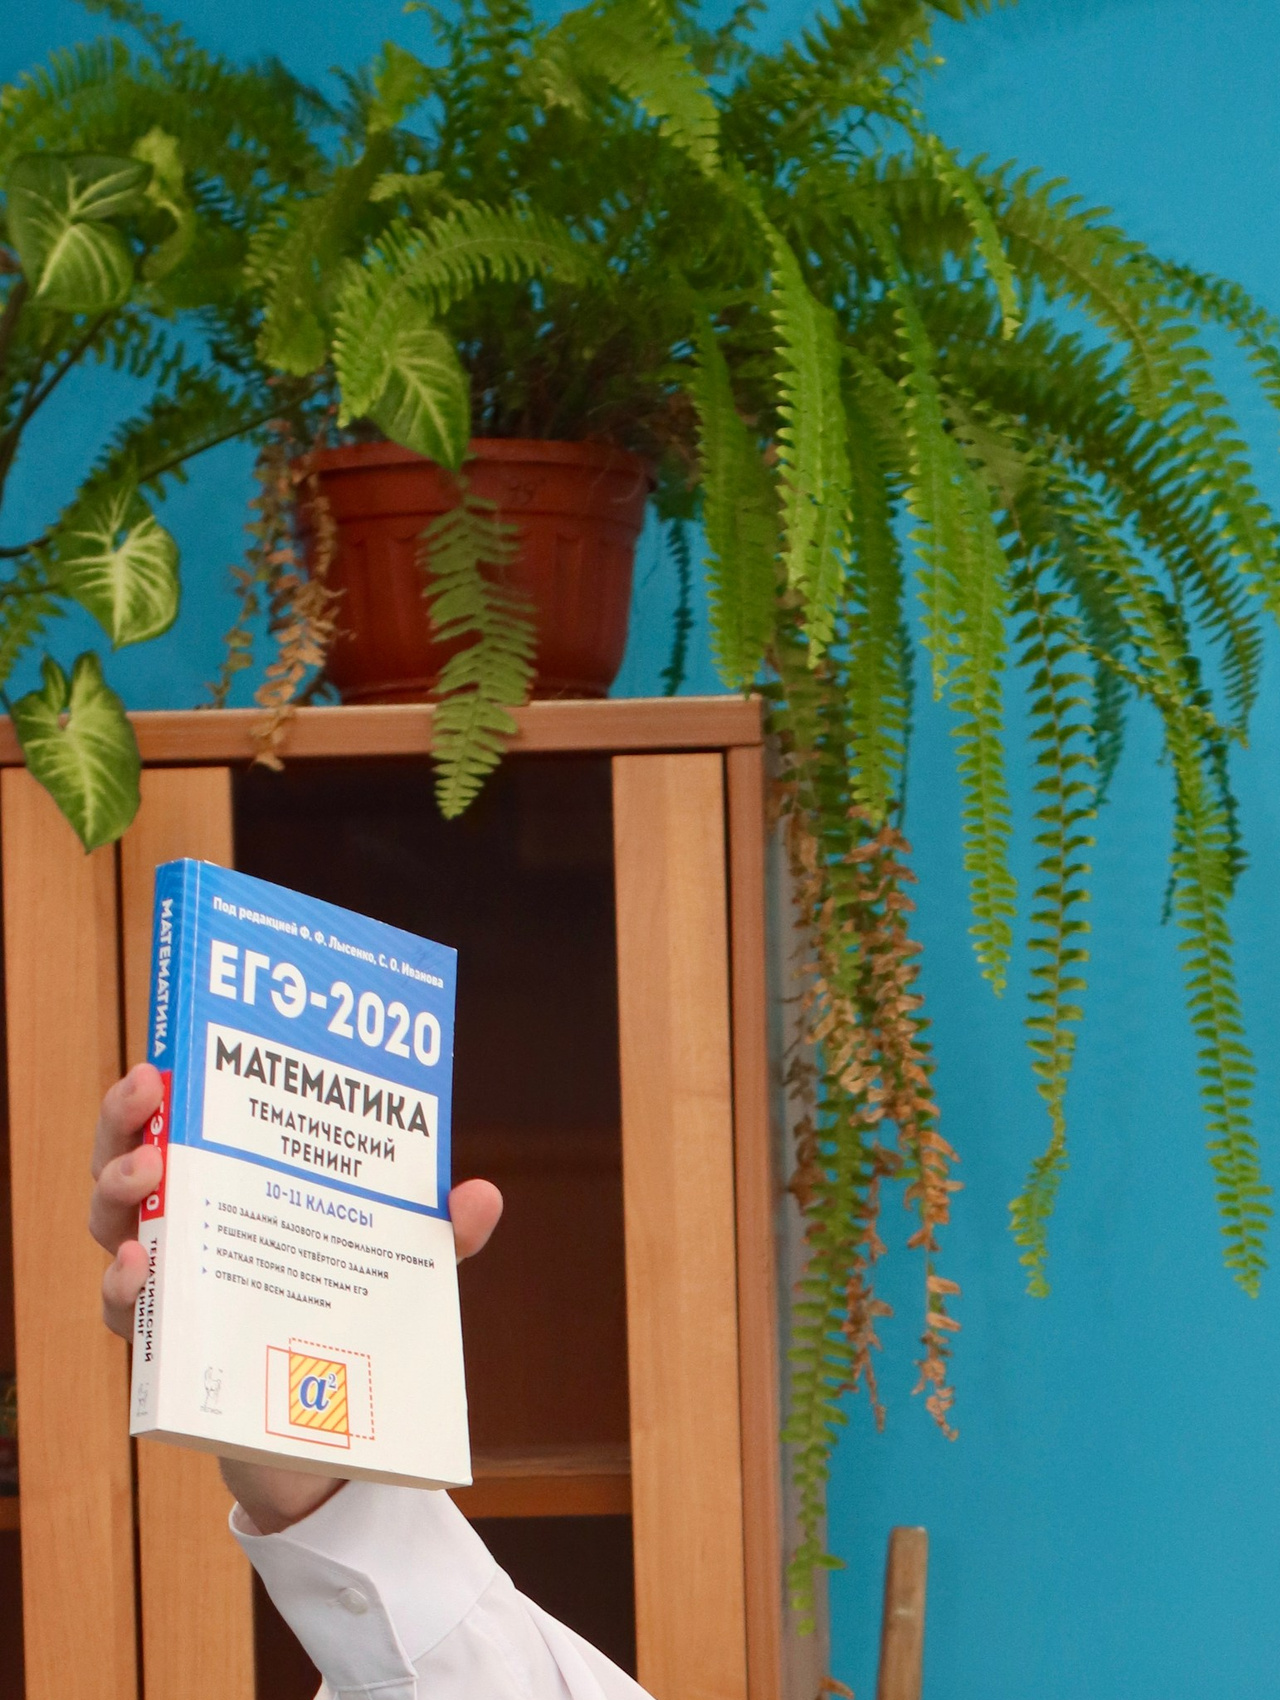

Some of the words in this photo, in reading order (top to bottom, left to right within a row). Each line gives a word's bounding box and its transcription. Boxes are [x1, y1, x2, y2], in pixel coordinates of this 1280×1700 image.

[212, 895, 238, 919] Под
[238, 908, 298, 936] редакцией
[299, 925, 313, 942] Ф.
[314, 930, 328, 947] Ф.
[328, 935, 377, 966] Лысенко,
[378, 953, 388, 970] С.
[389, 956, 400, 973] О.
[401, 959, 444, 989] Иванова
[154, 898, 174, 1058] МАТЕМАТИКА
[208, 938, 442, 1068] ЕГЭ-2020
[215, 1035, 430, 1138] МАТЕМАТИКА
[249, 1097, 396, 1163] ТЕМАТИЧЕСКИЙ
[281, 1135, 363, 1178] ТРЕНИНГ
[217, 1201, 238, 1215] 1500
[239, 1207, 279, 1227] ЗАДАНИЙ
[280, 1220, 322, 1240] БАЗОВОГО
[330, 1235, 394, 1259] ПРОФИЛЬНОГО
[395, 1252, 436, 1269] УРОВНЕЙ
[265, 1180, 302, 1208] 10-11
[306, 1194, 374, 1229] КЛАССЫ
[216, 1247, 254, 1265] КРАТКАЯ
[255, 1257, 286, 1273] ТЕОРИЯ
[286, 1267, 299, 1278] ПО
[300, 1271, 323, 1285] ВСЕМ
[323, 1277, 351, 1292] ТЕМАМ
[352, 1285, 369, 1297] ЕГЭ
[217, 1224, 258, 1244] РЕШЕНИЕ
[258, 1236, 297, 1255] КАЖДОГО
[298, 1247, 347, 1269] ЧЕТВЁРТОГО
[348, 1262, 389, 1280] ЗАДАНИЯ
[144, 1237, 158, 1362] ТЕМАТИЧЕСКИЙ
[215, 1269, 250, 1287] ОТВЕТЫ
[250, 1279, 263, 1290] КО
[263, 1283, 285, 1298] ВСЕМ
[286, 1289, 332, 1309] ЗАДАНИЯМ
